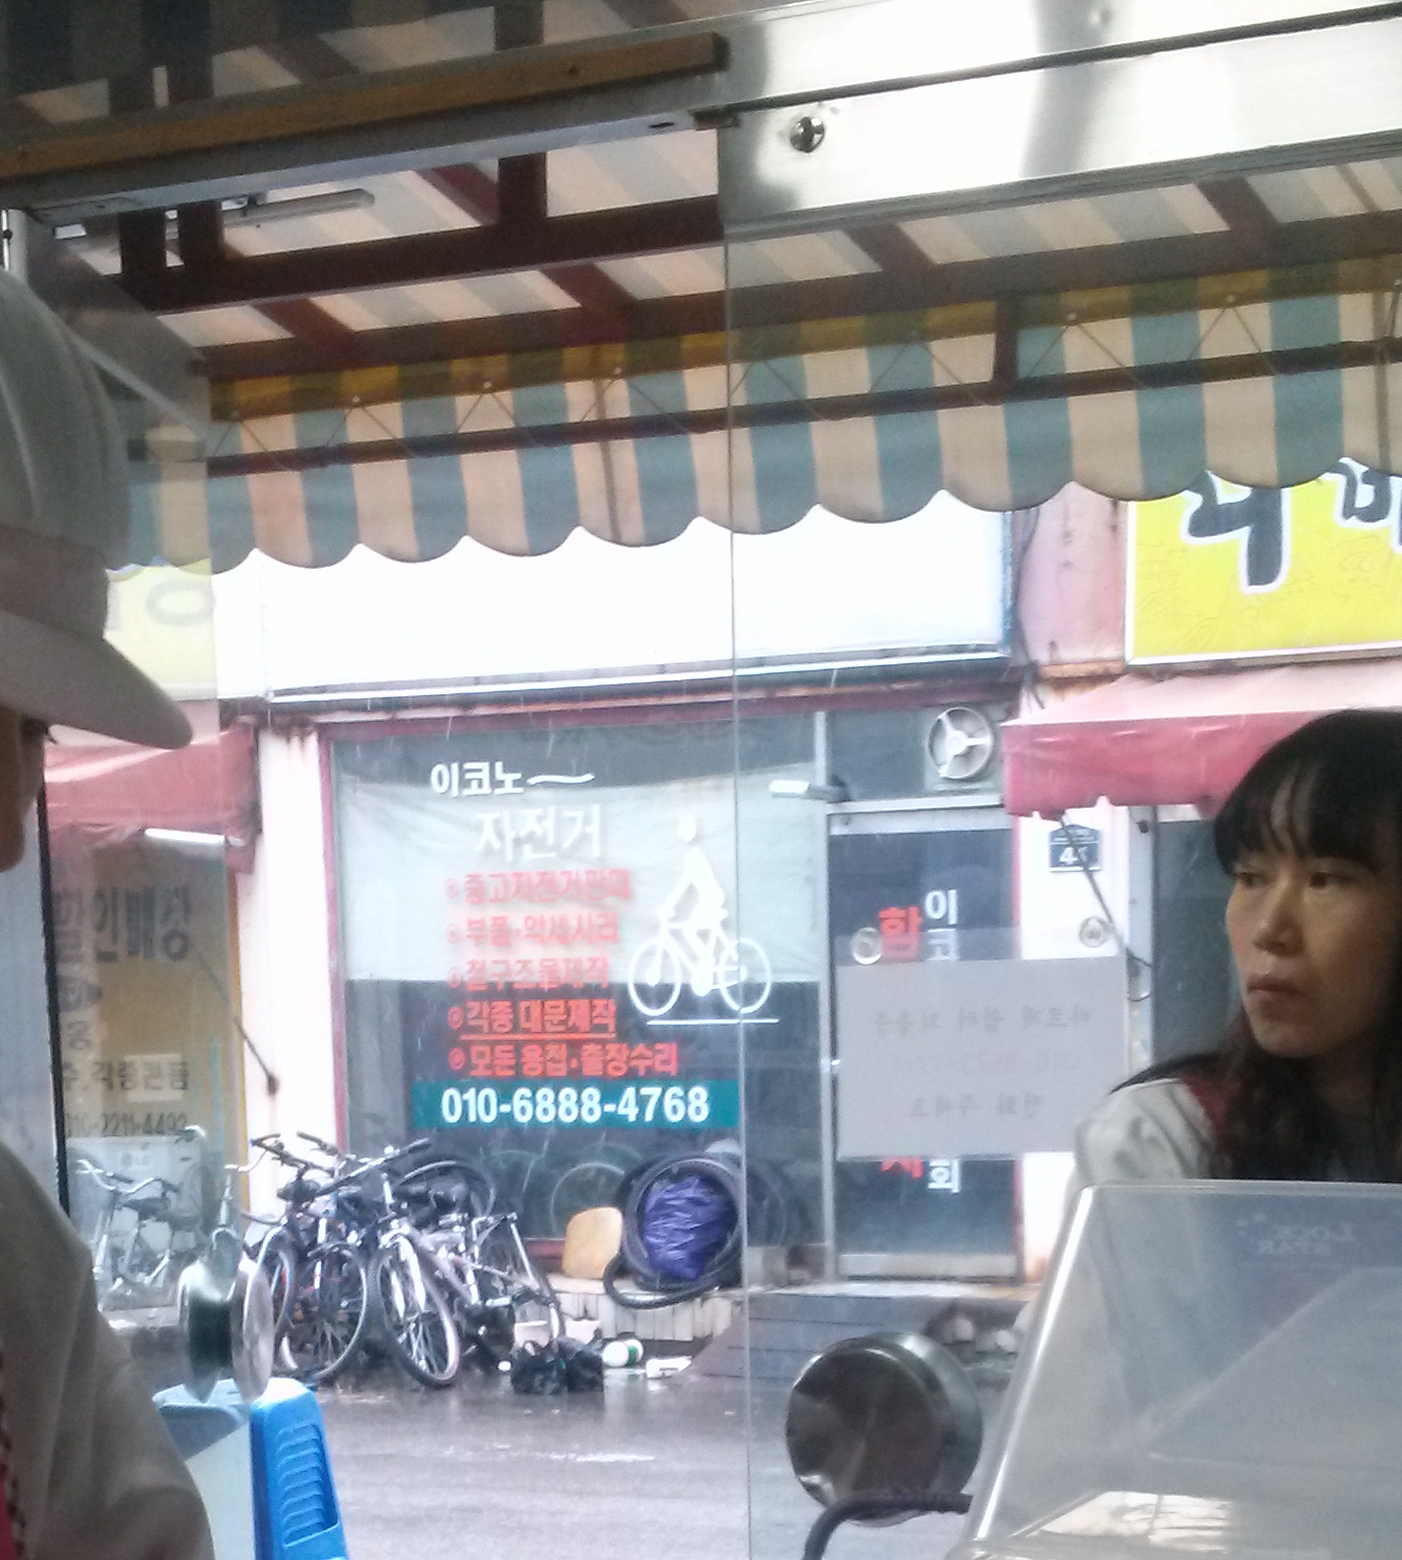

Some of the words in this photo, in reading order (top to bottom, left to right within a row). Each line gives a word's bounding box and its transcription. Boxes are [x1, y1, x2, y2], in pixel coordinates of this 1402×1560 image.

[431, 761, 524, 797] 이코노
[475, 804, 601, 861] 자전거
[466, 1001, 513, 1034] 각종
[470, 1044, 516, 1077] 모든
[441, 1086, 709, 1123] 010-6888-4768
